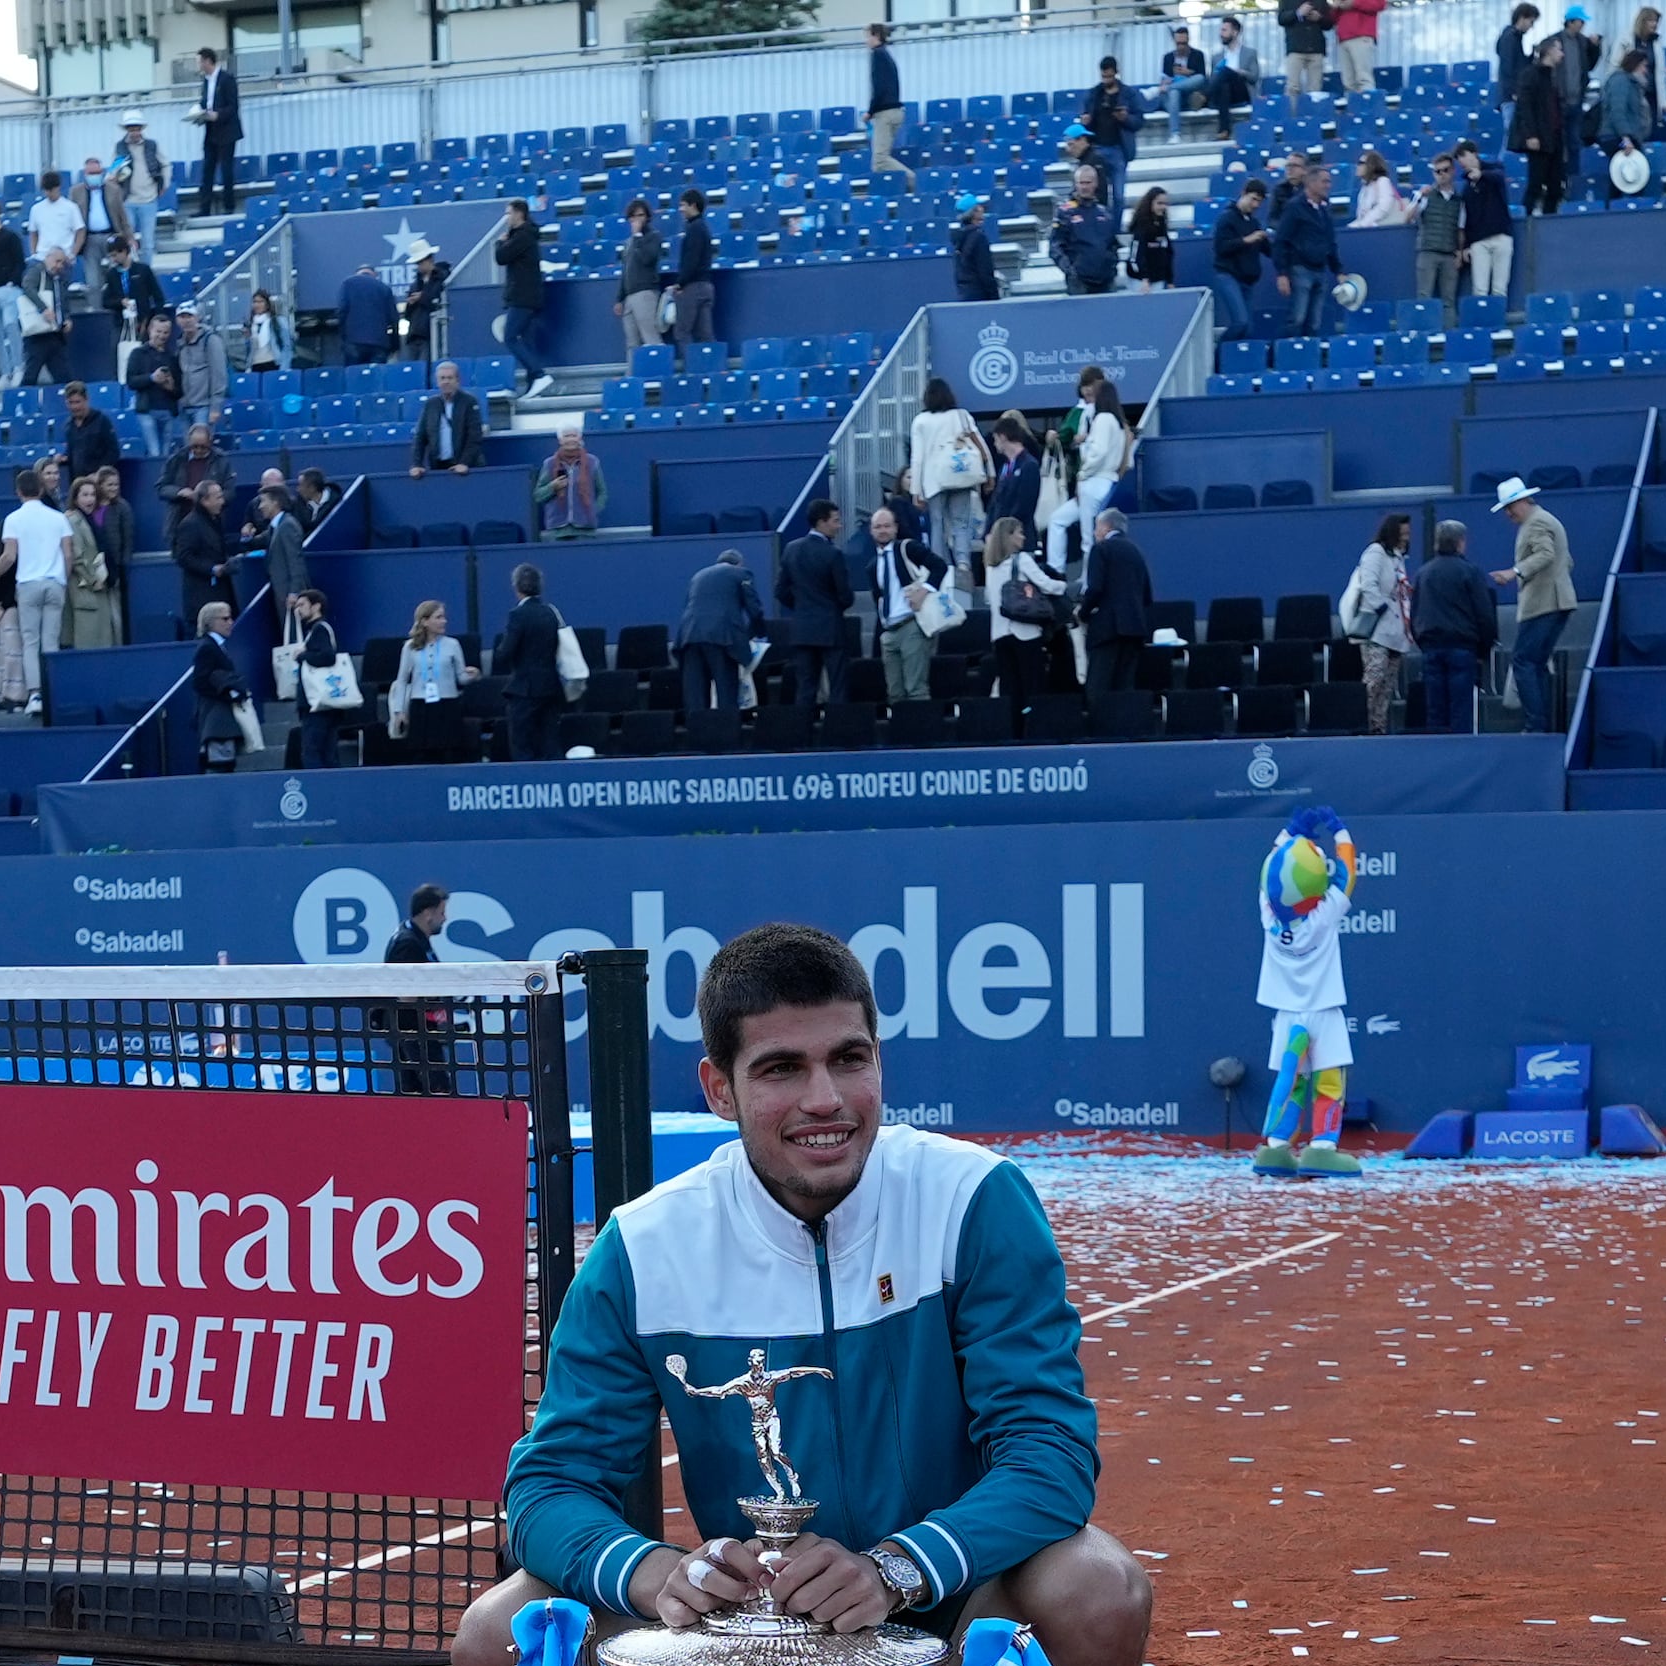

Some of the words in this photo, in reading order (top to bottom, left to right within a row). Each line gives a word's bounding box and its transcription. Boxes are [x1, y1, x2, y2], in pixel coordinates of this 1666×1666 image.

[448, 783, 564, 811] BARCELONA
[568, 780, 622, 807] OPEN
[626, 778, 681, 805] BANC
[685, 776, 789, 803] SABADELL
[792, 773, 833, 800] 69è
[836, 771, 916, 799] TROFEU
[920, 769, 992, 797] CONDE
[997, 767, 1025, 794] DE
[1029, 758, 1089, 793] GODÓ
[89, 877, 182, 901] Sabadell
[91, 929, 183, 953] Sabadell
[1073, 1103, 1179, 1125] Sabadell
[1484, 1130, 1575, 1144] LACOSTE
[135, 1314, 394, 1422] BETTER
